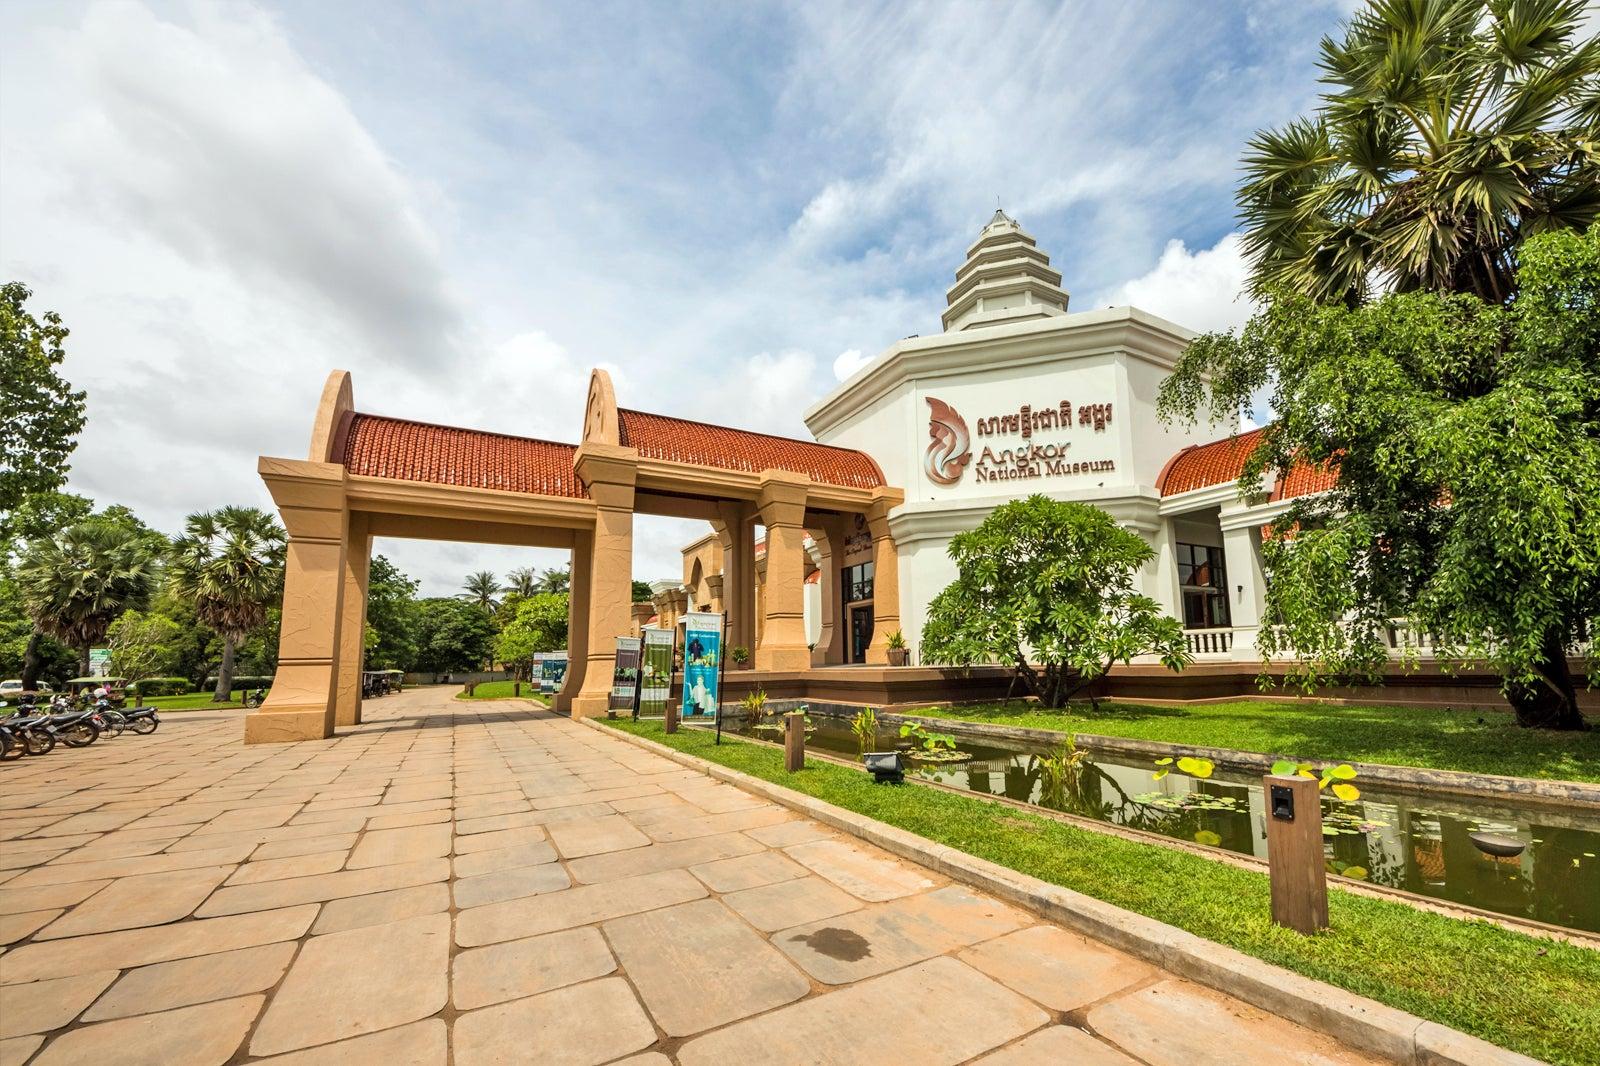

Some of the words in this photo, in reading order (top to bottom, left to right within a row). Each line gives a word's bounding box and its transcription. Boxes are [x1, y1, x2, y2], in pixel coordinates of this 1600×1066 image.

[976, 440, 1071, 468] Angkor
[975, 463, 1041, 482] National
[1045, 459, 1115, 477] Museum
